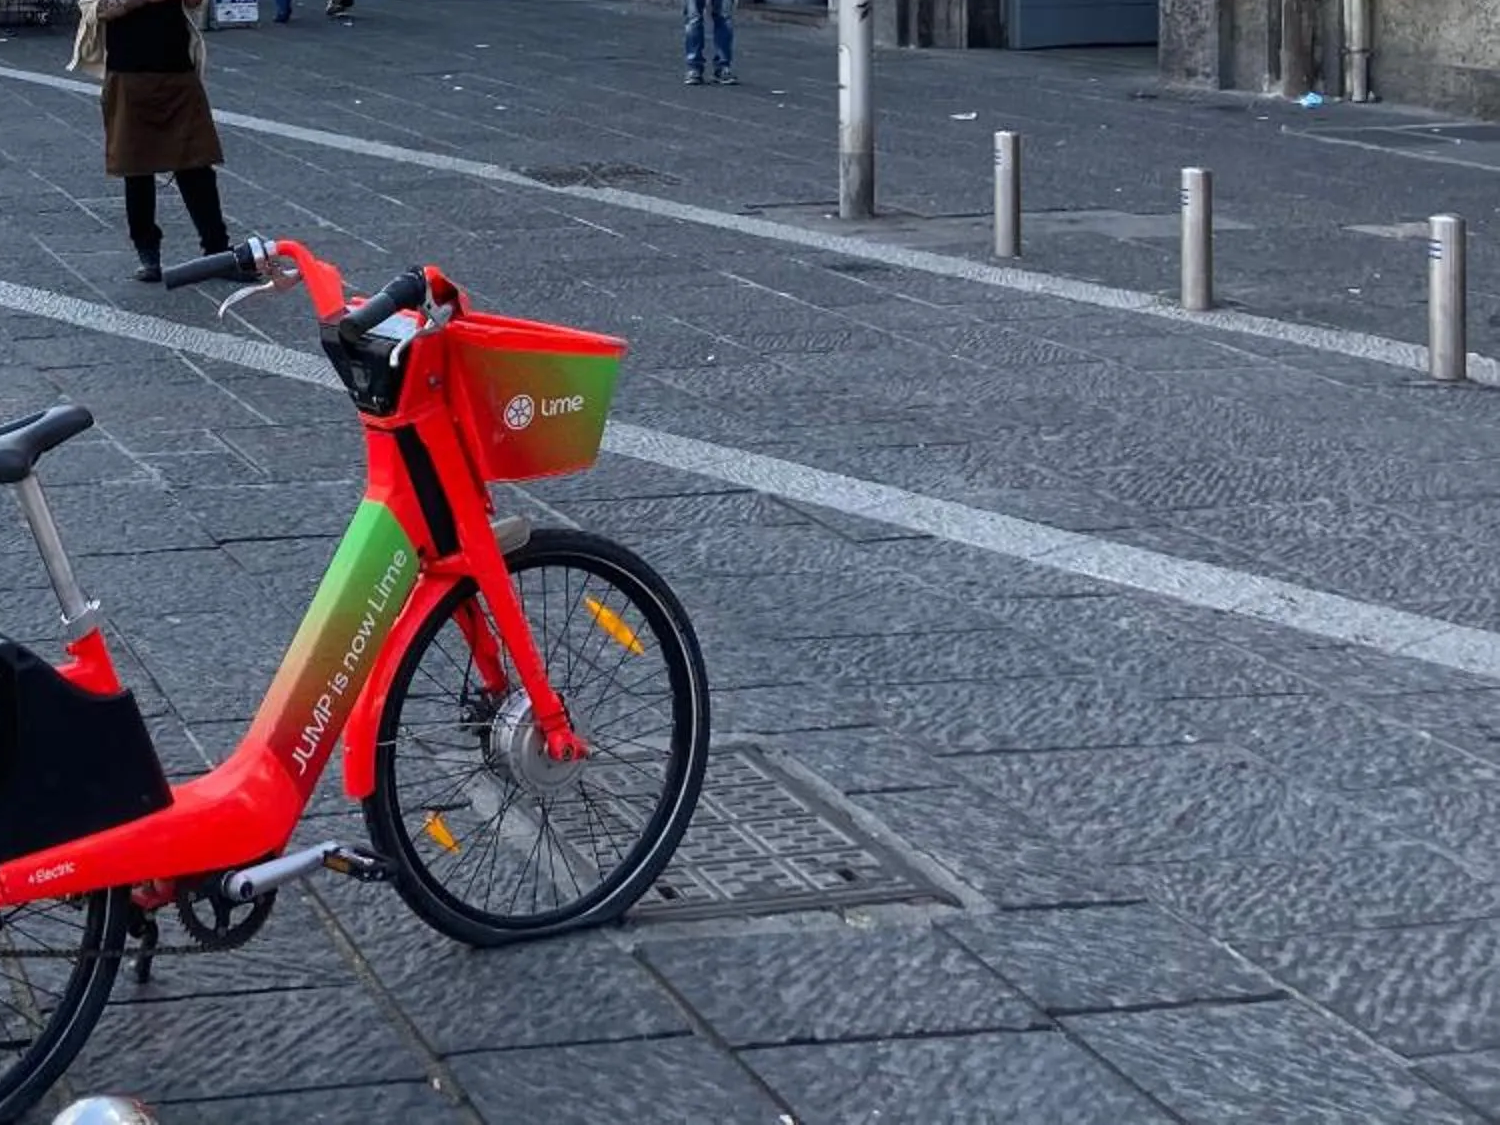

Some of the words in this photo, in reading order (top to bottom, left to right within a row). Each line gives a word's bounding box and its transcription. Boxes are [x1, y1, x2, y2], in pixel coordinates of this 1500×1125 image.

[541, 394, 585, 416] Lime
[292, 692, 333, 776] JUMP
[327, 674, 349, 697] is
[343, 611, 376, 672] now
[368, 548, 408, 614] Lime
[35, 861, 76, 883] Electric
